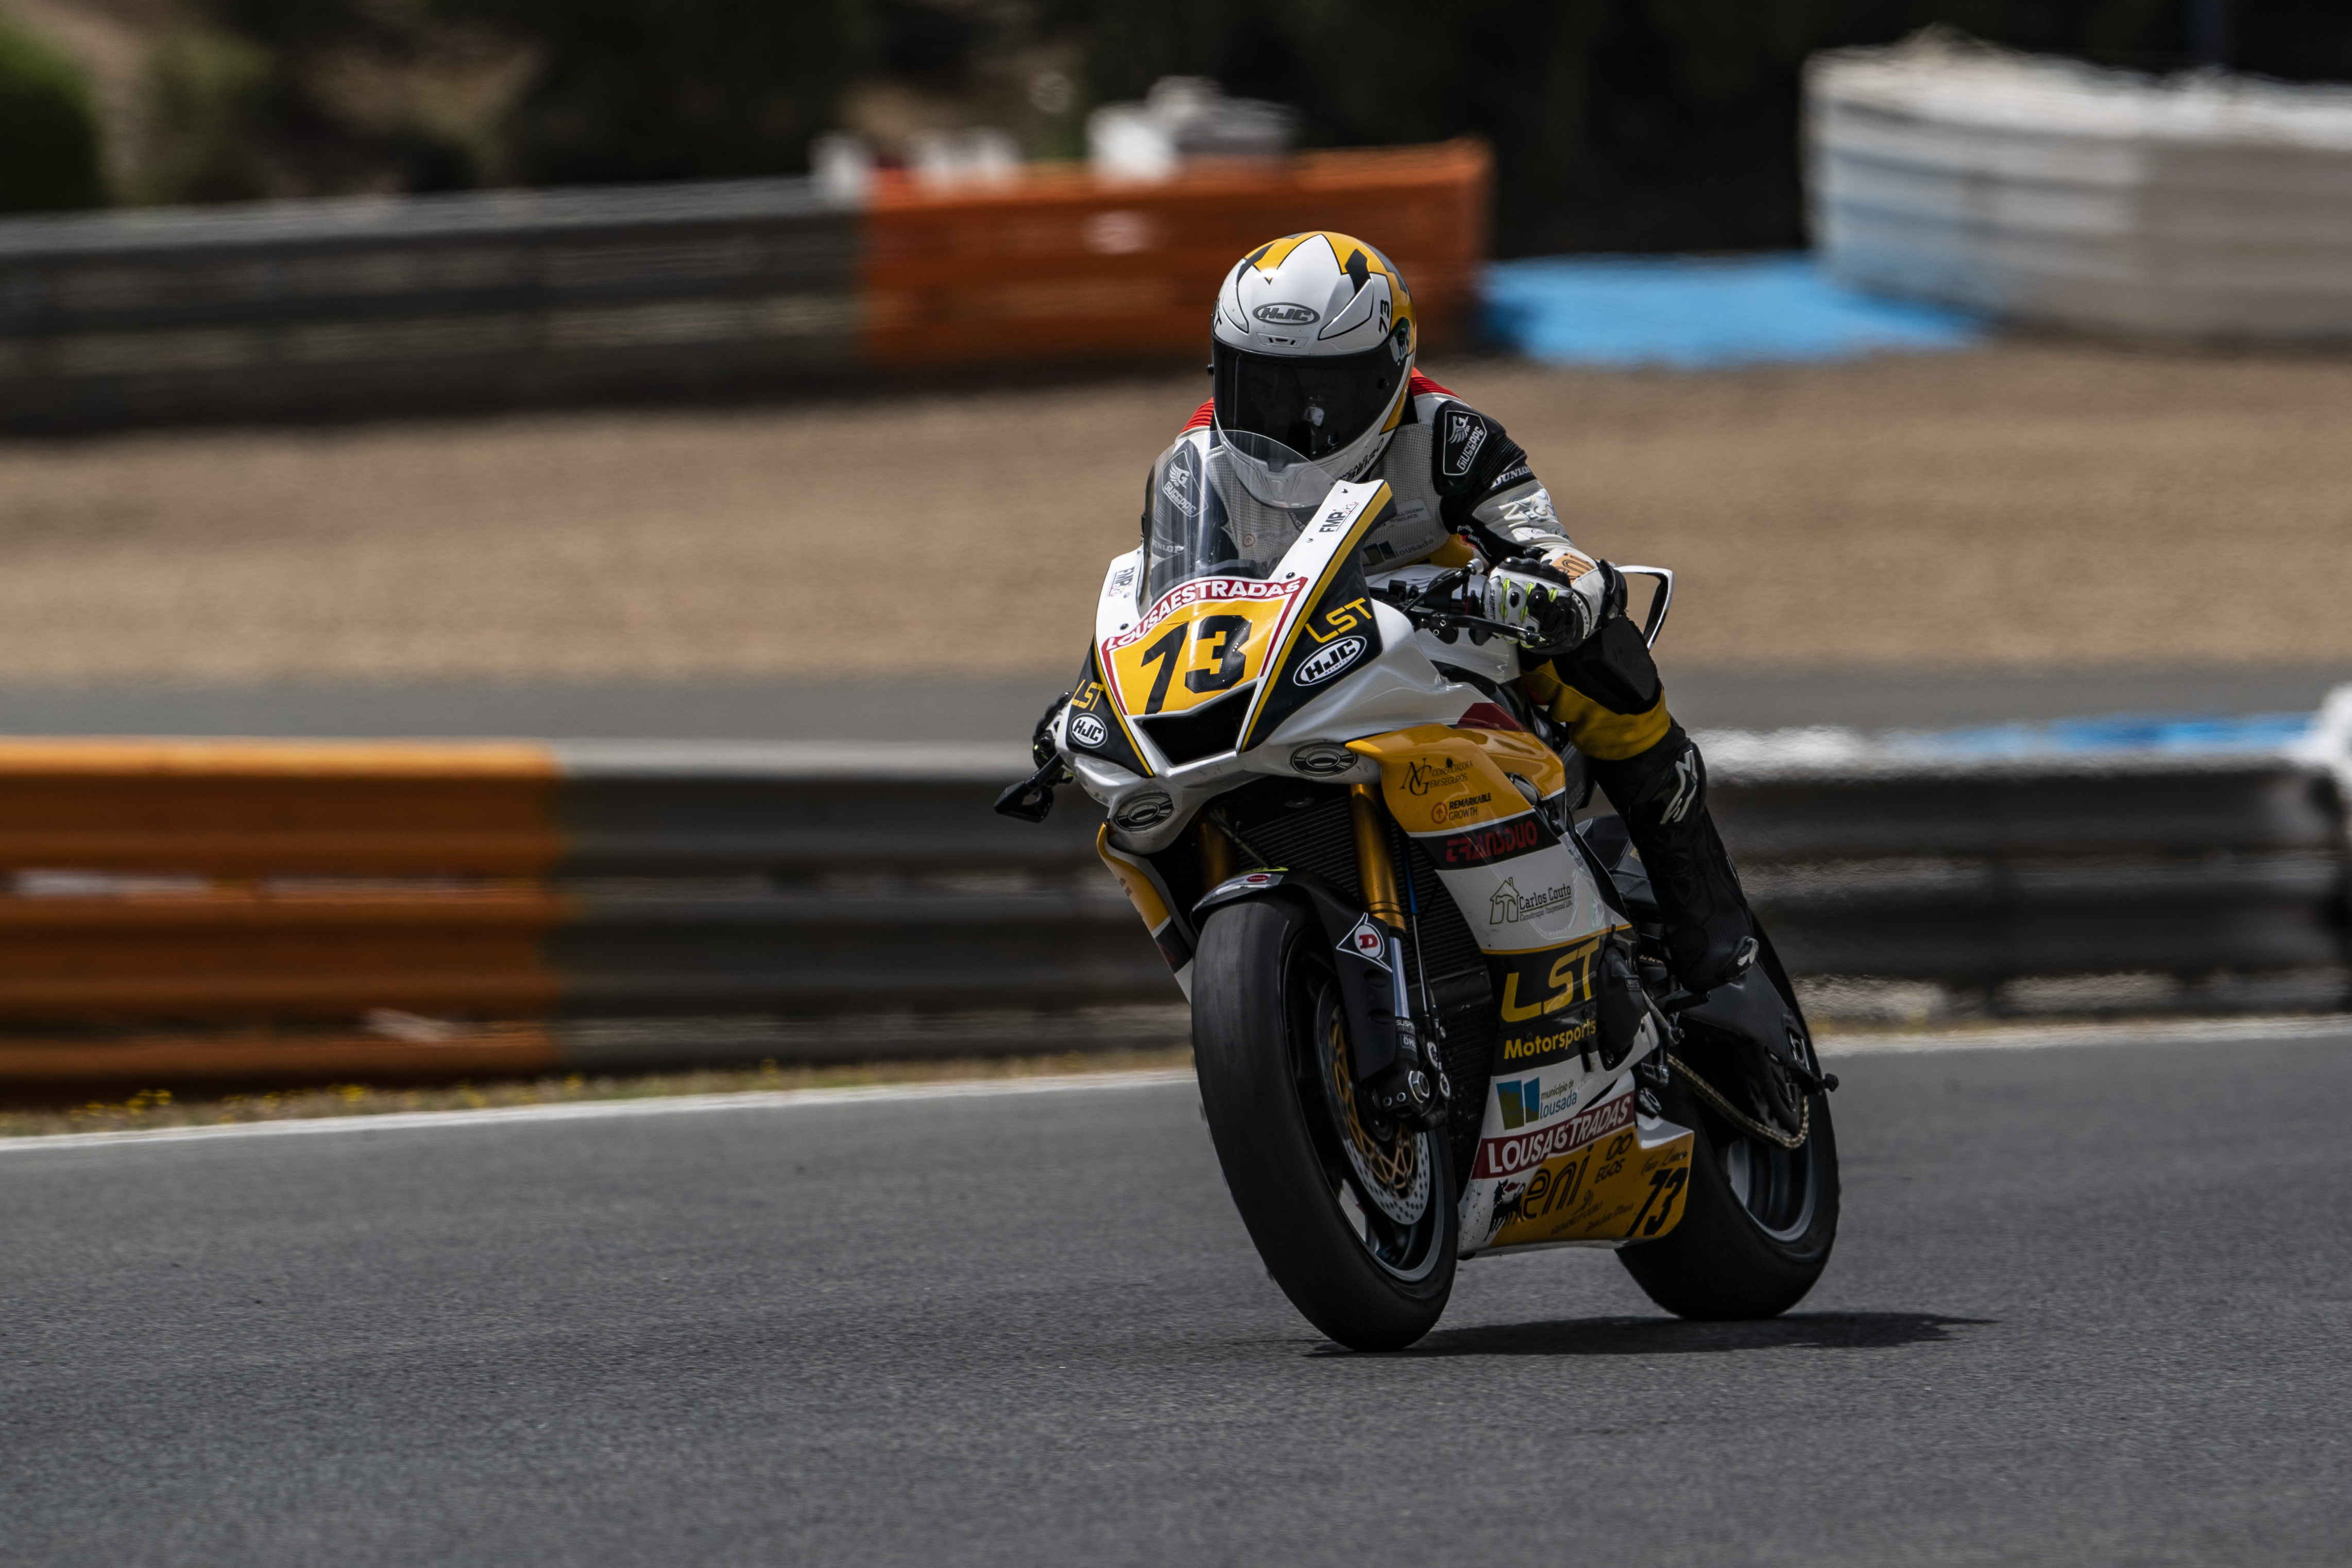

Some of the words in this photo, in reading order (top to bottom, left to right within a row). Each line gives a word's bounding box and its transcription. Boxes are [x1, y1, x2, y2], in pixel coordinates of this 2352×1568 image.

[1260, 307, 1312, 321] HJC
[1378, 299, 1390, 335] 73
[1456, 426, 1485, 471] GIUSEPPE
[1319, 511, 1346, 533] FMP
[1395, 538, 1434, 557] lousada
[1105, 580, 1301, 651] LOUSAESTRADAS
[1305, 597, 1372, 643] LST
[1140, 615, 1252, 715] 73
[1304, 639, 1357, 681] HJC
[1324, 659, 1349, 674] HELMETS
[1071, 679, 1104, 711] LST
[1073, 719, 1103, 742] HJC
[1441, 773, 1468, 787] SEGUROS
[1448, 806, 1478, 821] GROWTH
[1449, 793, 1492, 811] REMARKABLE
[1519, 892, 1547, 910] Carlos
[1548, 883, 1572, 901] Couto
[1501, 939, 1600, 1022] LST
[1504, 1018, 1597, 1060] Motorsports
[1540, 1089, 1577, 1119] lousada
[1541, 1081, 1568, 1100] município
[1568, 1078, 1574, 1089] de
[1523, 1143, 1595, 1220] eni
[1594, 1157, 1626, 1185] EGOS
[1624, 1167, 1689, 1237] 73
